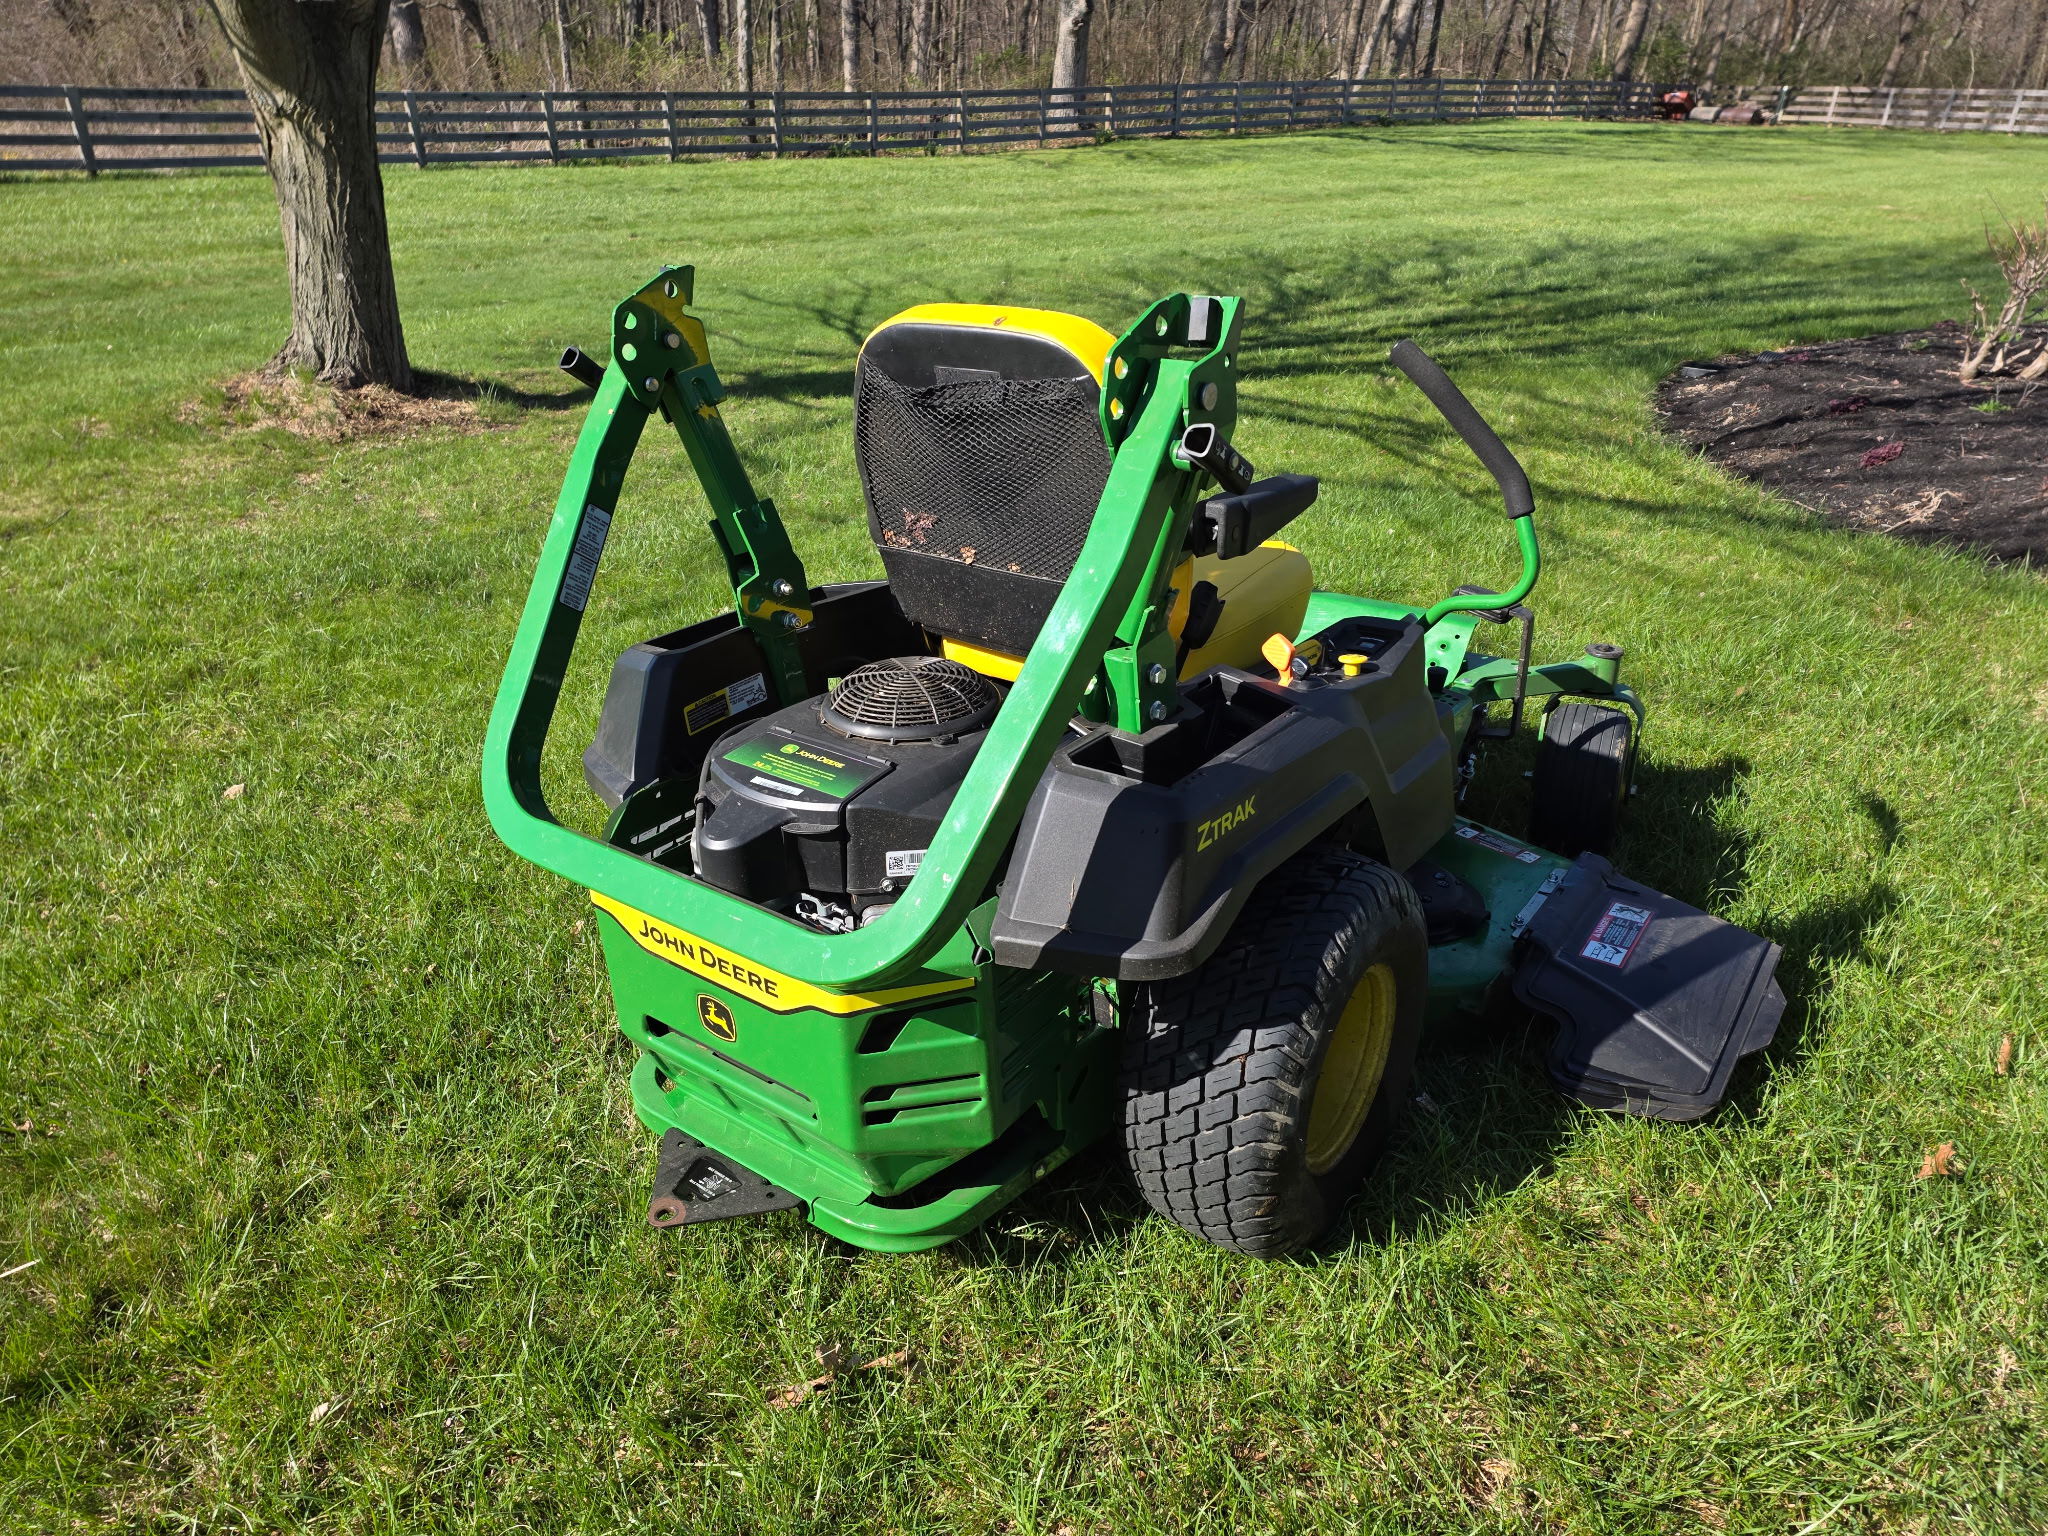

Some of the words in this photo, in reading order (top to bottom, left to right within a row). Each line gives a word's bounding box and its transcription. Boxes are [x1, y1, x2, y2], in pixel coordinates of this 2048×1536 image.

[795, 749, 818, 761] JOHN
[1196, 794, 1256, 853] ZTRAK
[639, 919, 696, 961] JOHN
[699, 945, 779, 999] DEERE
